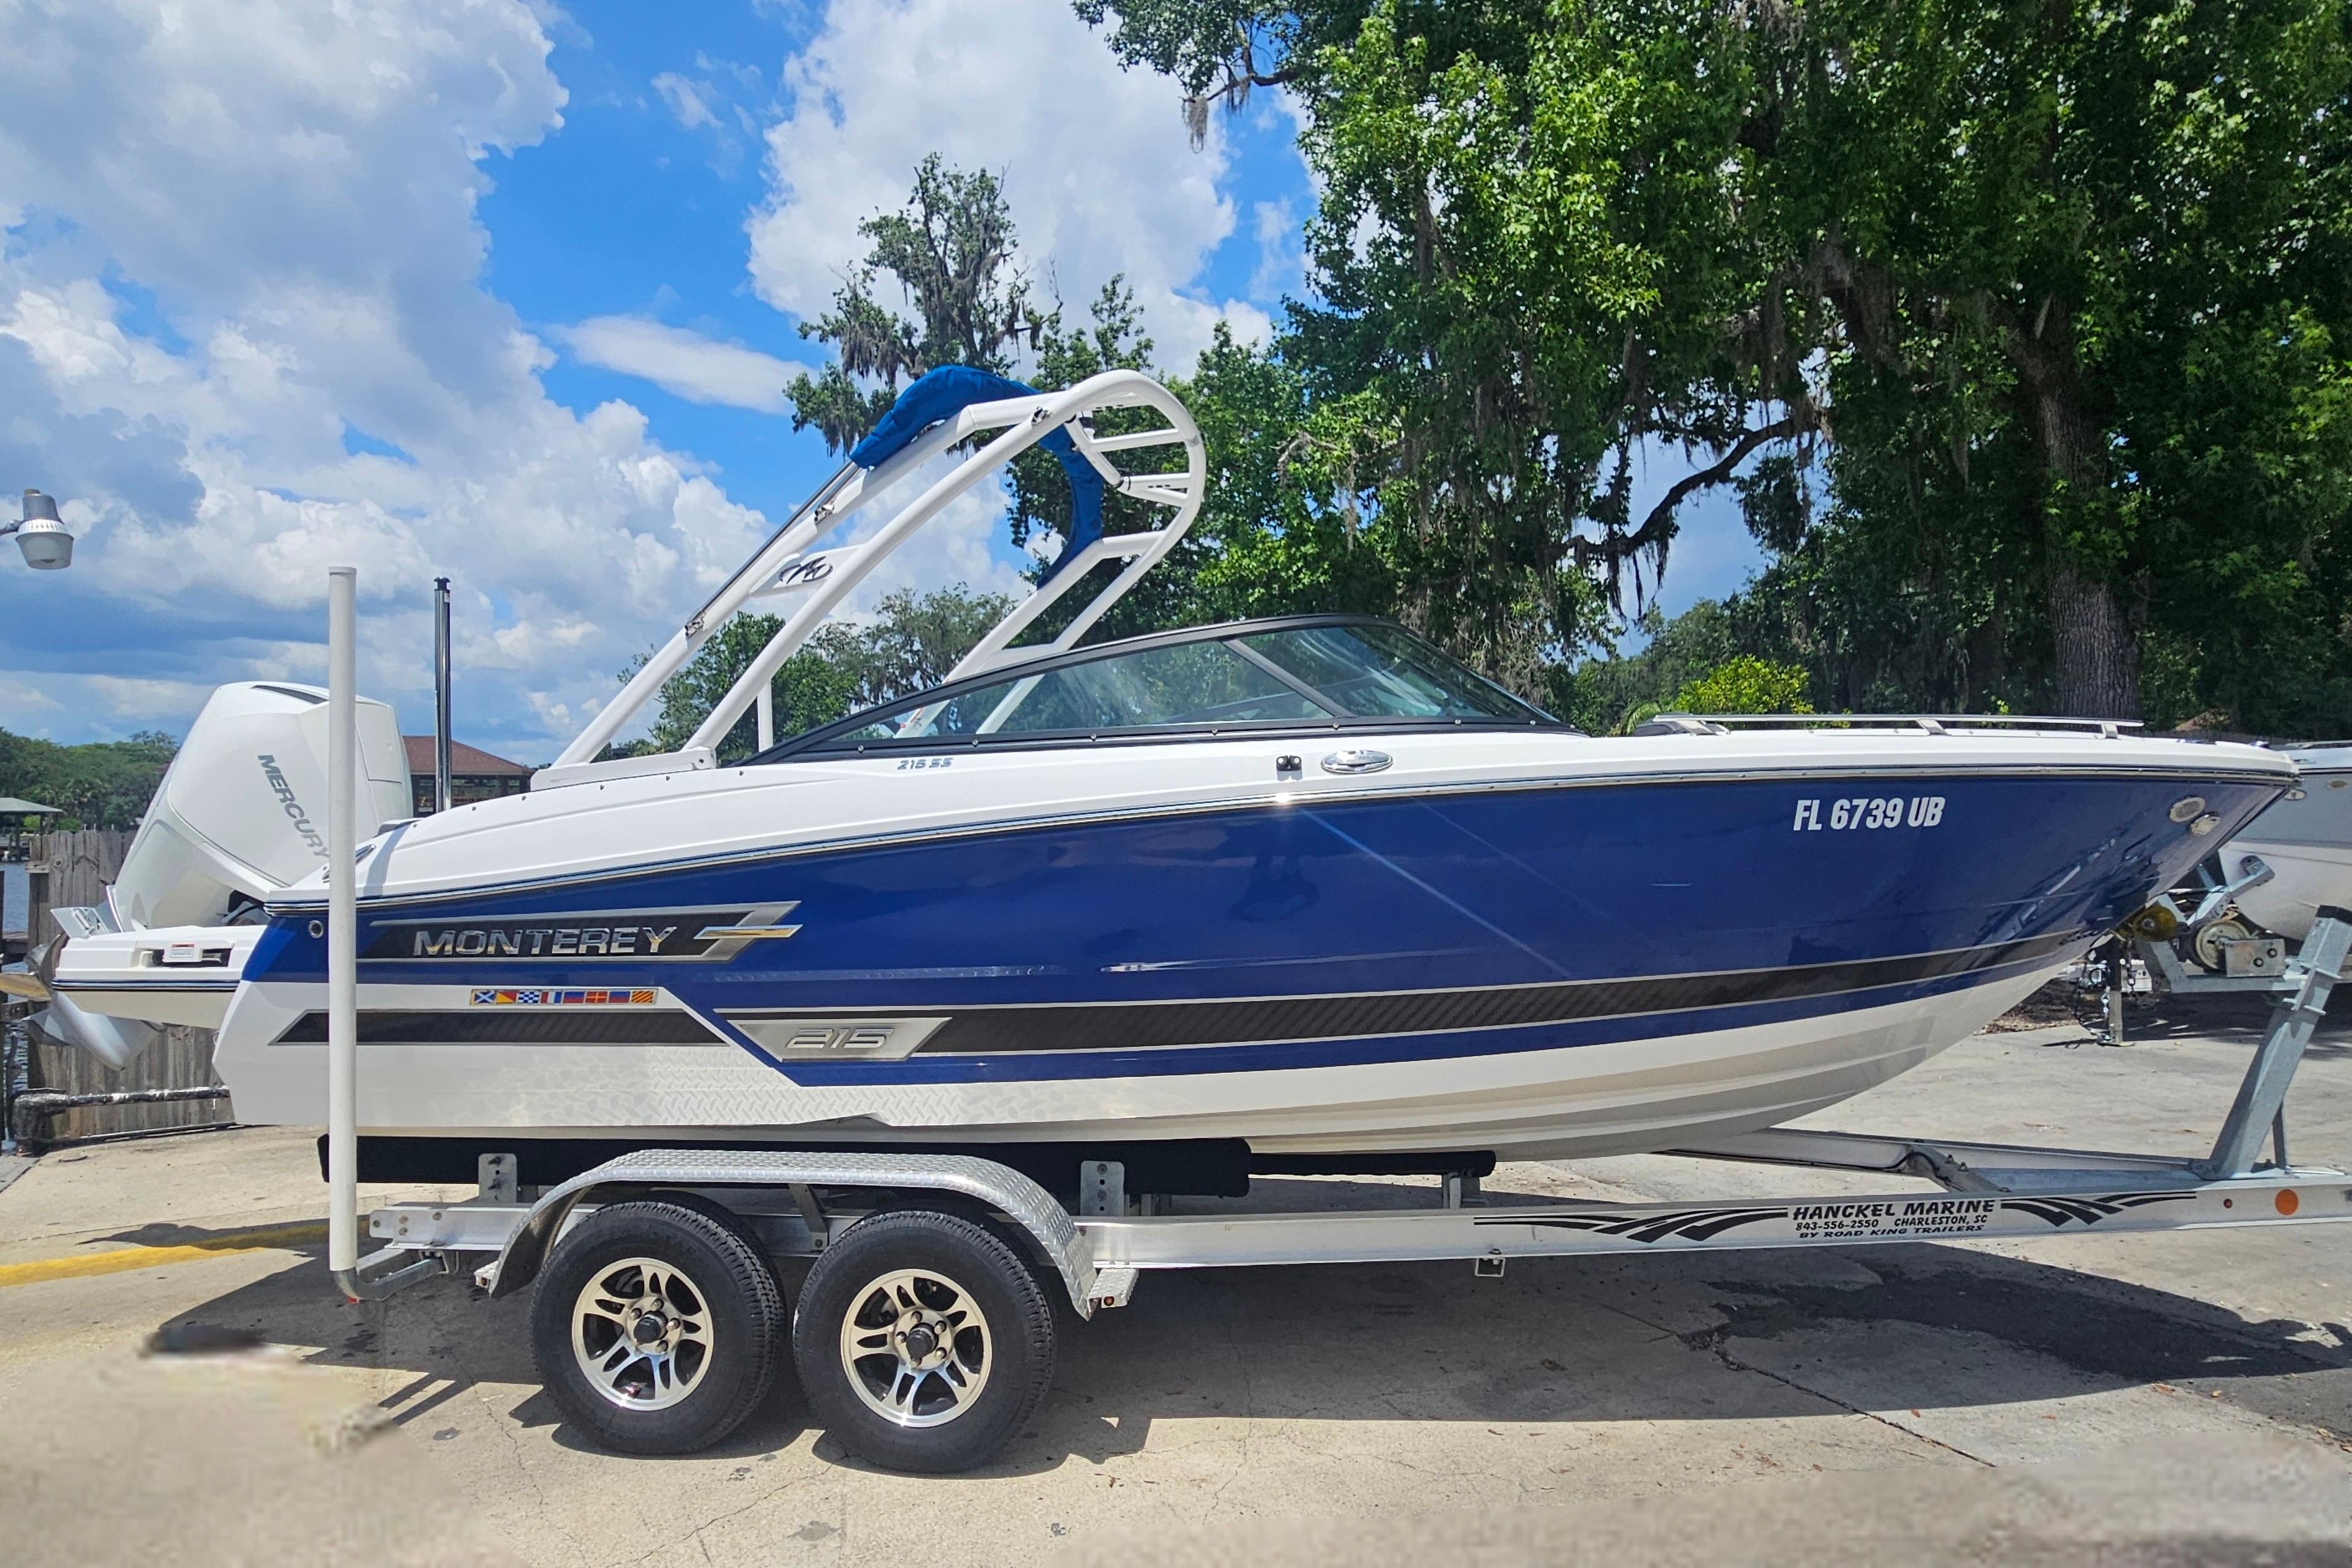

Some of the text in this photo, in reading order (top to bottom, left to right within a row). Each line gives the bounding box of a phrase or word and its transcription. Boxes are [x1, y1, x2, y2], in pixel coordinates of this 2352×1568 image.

[257, 755, 330, 858] MERCURY
[1793, 797, 1945, 831] FL 6739 UB
[413, 926, 677, 955] MONTEREY
[785, 1027, 894, 1049] 215
[1793, 1200, 1995, 1220] HANCKEL MARINE
[1796, 1214, 1987, 1231] 843-556-2550 CHARLESTON, SC
[1824, 1230, 1864, 1238] ROAD
[1869, 1227, 1908, 1235] KING
[1914, 1225, 1984, 1234] TRAILERS
